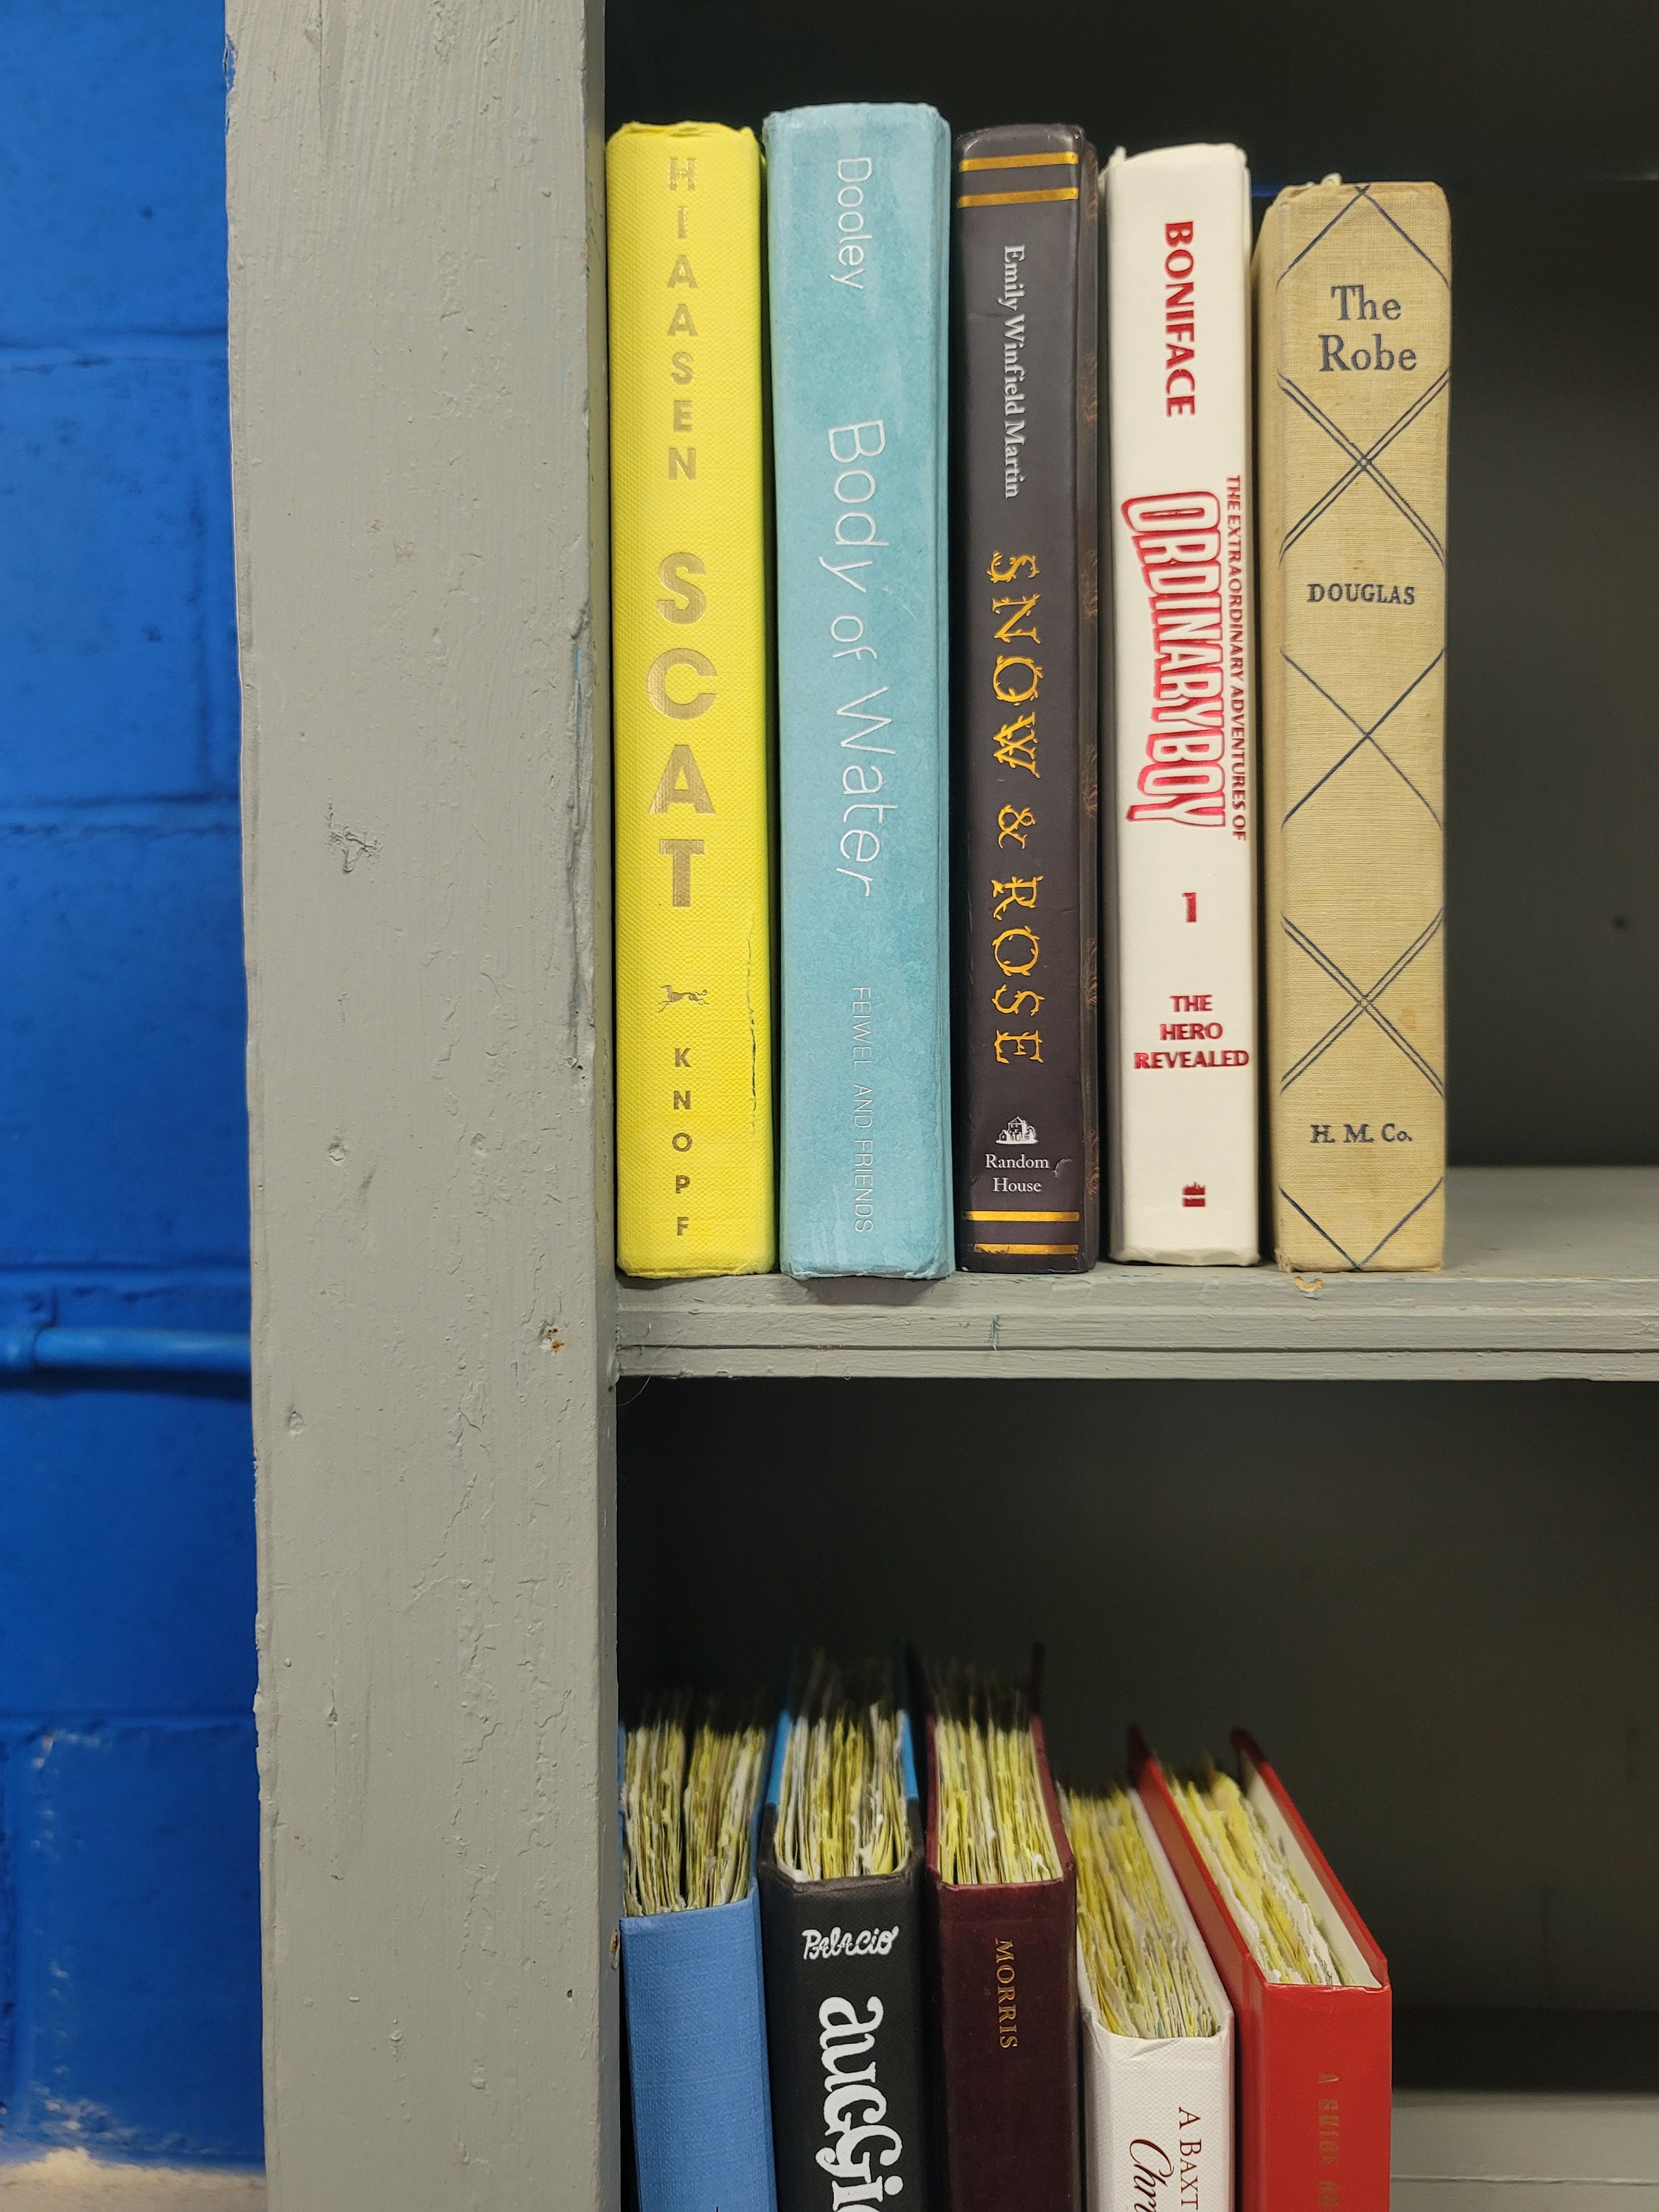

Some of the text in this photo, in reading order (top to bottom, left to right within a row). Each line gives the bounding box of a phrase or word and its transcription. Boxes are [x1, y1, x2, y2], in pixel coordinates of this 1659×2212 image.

[830, 157, 872, 291] Dooley
[667, 158, 699, 481] HIAASEN
[1164, 220, 1196, 418] BONIFACE
[1318, 334, 1417, 372] Robe
[1331, 284, 1402, 321] The
[997, 245, 1026, 499] Emily Winfield Martin
[1307, 583, 1416, 605] DOUGLAS
[818, 420, 899, 897] Body of Water
[1226, 475, 1247, 841] THE EXTRAORDINARY ADVENTURES OF
[646, 552, 719, 908] SCAT
[986, 550, 1045, 1065] SNOW & ROSE
[1181, 891, 1197, 923] 1
[1160, 1022, 1223, 1040] HERO
[1169, 994, 1213, 1012] THE
[852, 986, 874, 1234] FEIWEL AND FRIENDS
[1133, 1050, 1250, 1069] REVEALED
[671, 1048, 693, 1236] KNOPF
[984, 1152, 1050, 1170] Random
[992, 1177, 1042, 1193] House
[1310, 1124, 1412, 1144] H. M. Co.
[995, 1937, 1018, 2049] MORRIS
[1178, 2106, 1203, 2212] A BAXT
